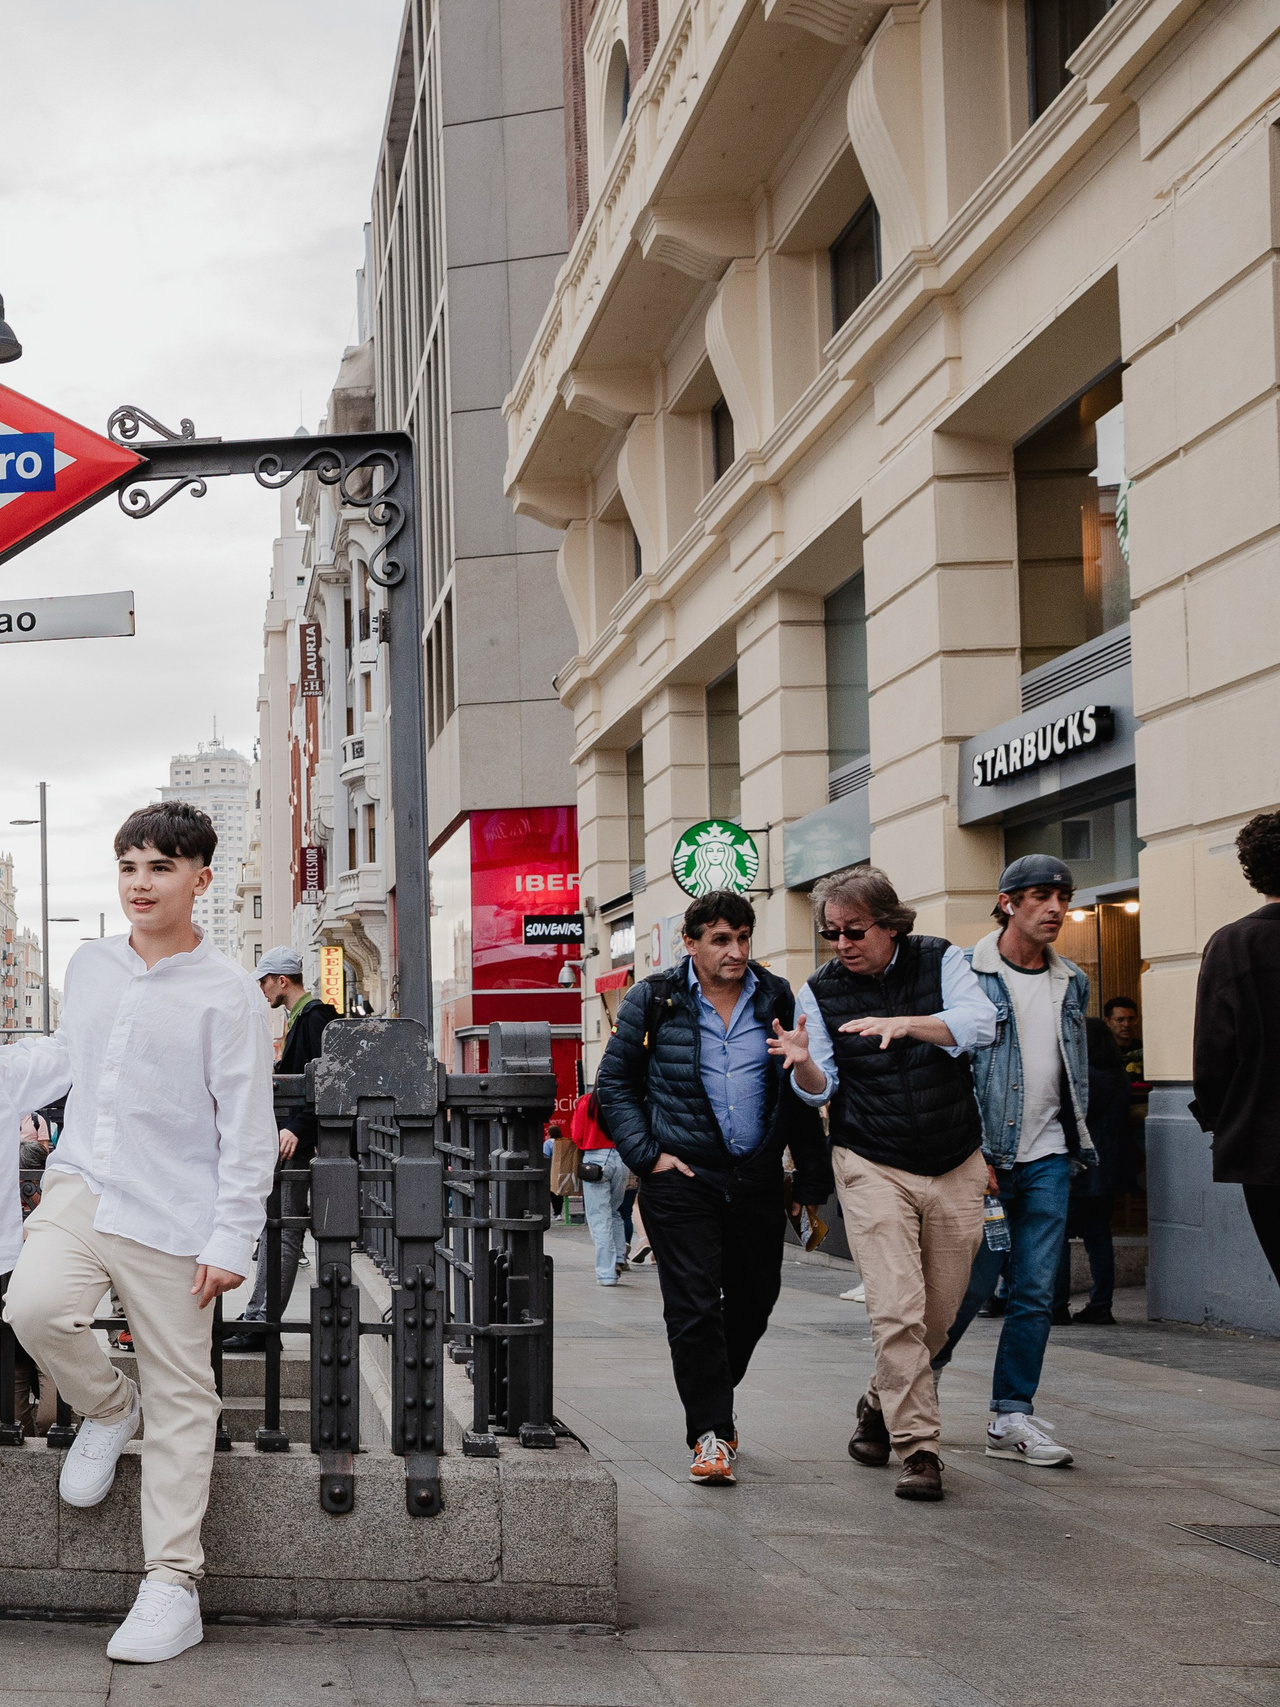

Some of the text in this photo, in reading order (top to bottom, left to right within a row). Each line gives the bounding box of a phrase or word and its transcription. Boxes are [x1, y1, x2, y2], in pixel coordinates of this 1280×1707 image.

[305, 626, 318, 679] LAURIA
[972, 704, 1097, 787] STARBUCKS
[306, 848, 319, 890] EXCELSIOR
[525, 923, 583, 937] SOUVENIRS
[324, 948, 340, 1013] PELUCA
